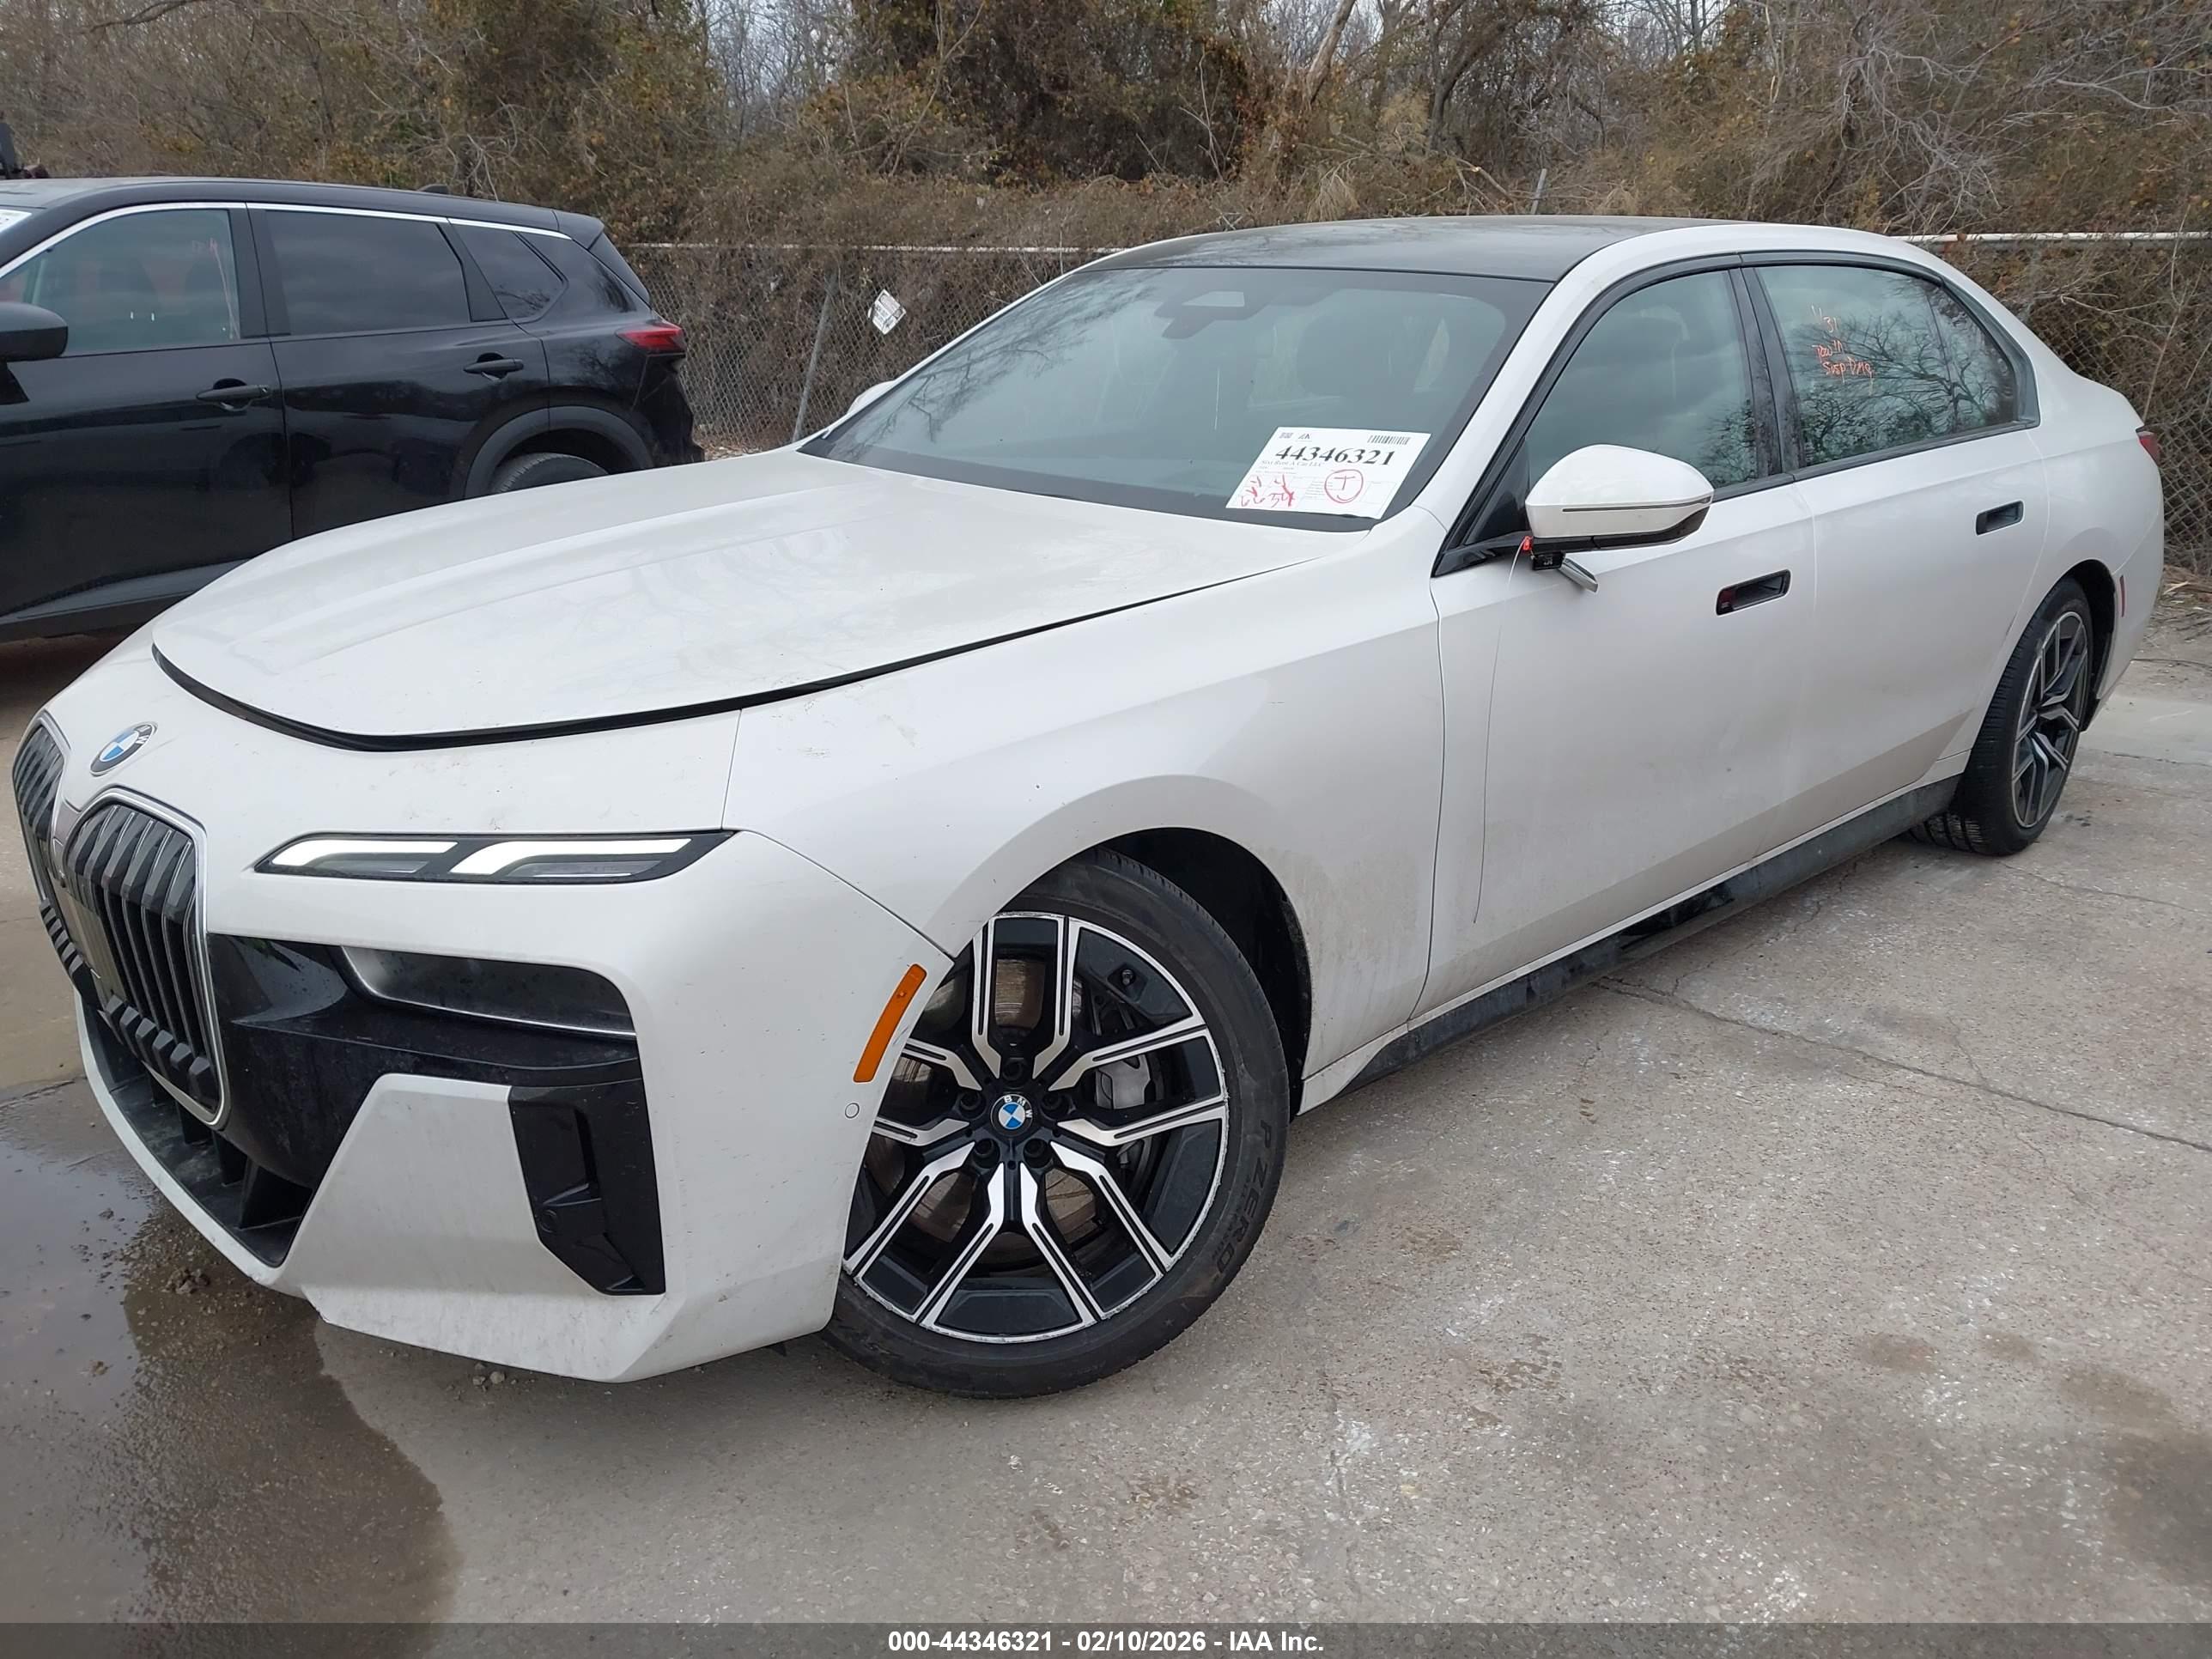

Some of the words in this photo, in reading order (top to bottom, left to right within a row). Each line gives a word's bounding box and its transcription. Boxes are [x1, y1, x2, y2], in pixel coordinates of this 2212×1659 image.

[1275, 446, 1395, 465] 44346321
[1003, 1095, 1033, 1118] BMW
[1216, 1159, 1268, 1275] ZERO
